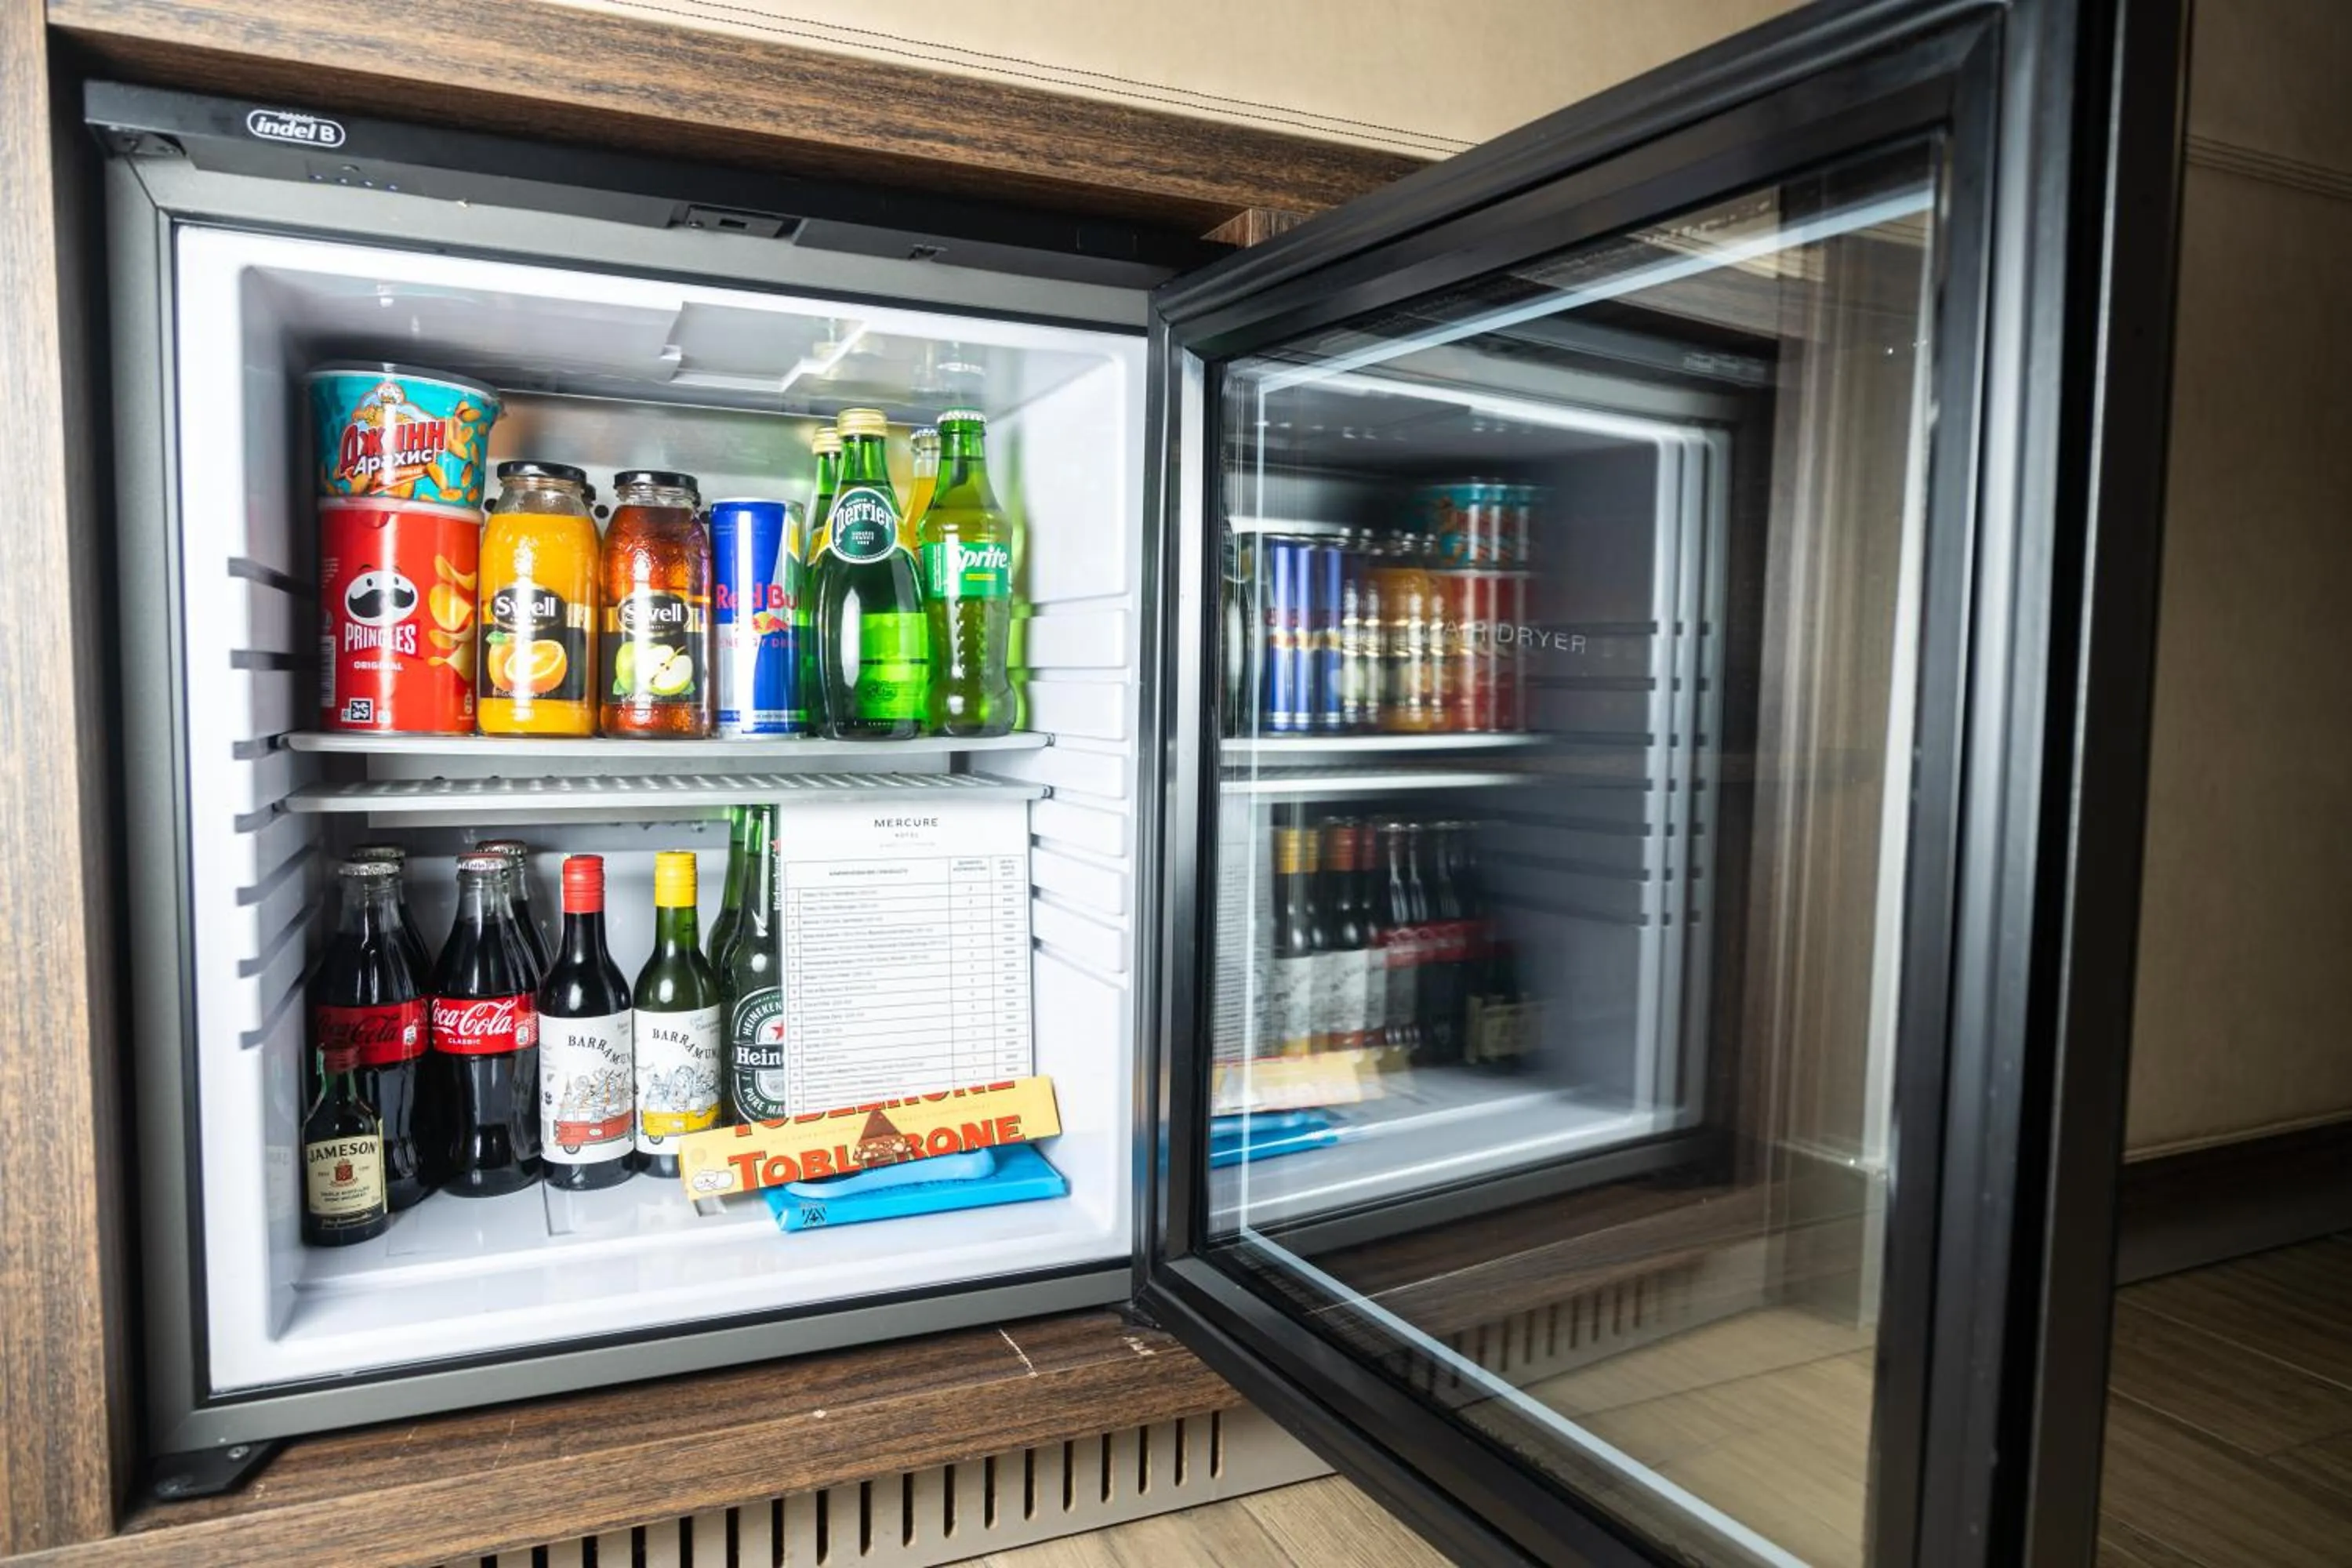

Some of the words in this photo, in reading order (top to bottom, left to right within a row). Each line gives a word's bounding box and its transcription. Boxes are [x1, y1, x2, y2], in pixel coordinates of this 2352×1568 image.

[256, 115, 316, 140] indel
[319, 126, 336, 143] B
[951, 543, 1008, 573] Sprite
[495, 596, 555, 617] Swell
[717, 584, 761, 608] Red
[768, 583, 803, 610] Bu
[345, 622, 416, 655] PRINGLES
[716, 636, 767, 648] ENEGY
[1497, 622, 1586, 655] DRYER
[873, 817, 939, 829] MERCURE
[742, 1000, 784, 1036] HEINEKEN
[447, 1036, 481, 1045] CLASSIC
[736, 1046, 785, 1066] Hein
[743, 1087, 766, 1112] PURE
[766, 1104, 786, 1116] MA
[308, 1141, 377, 1163] JAMESON
[728, 1114, 1027, 1191] TOBLRONE
